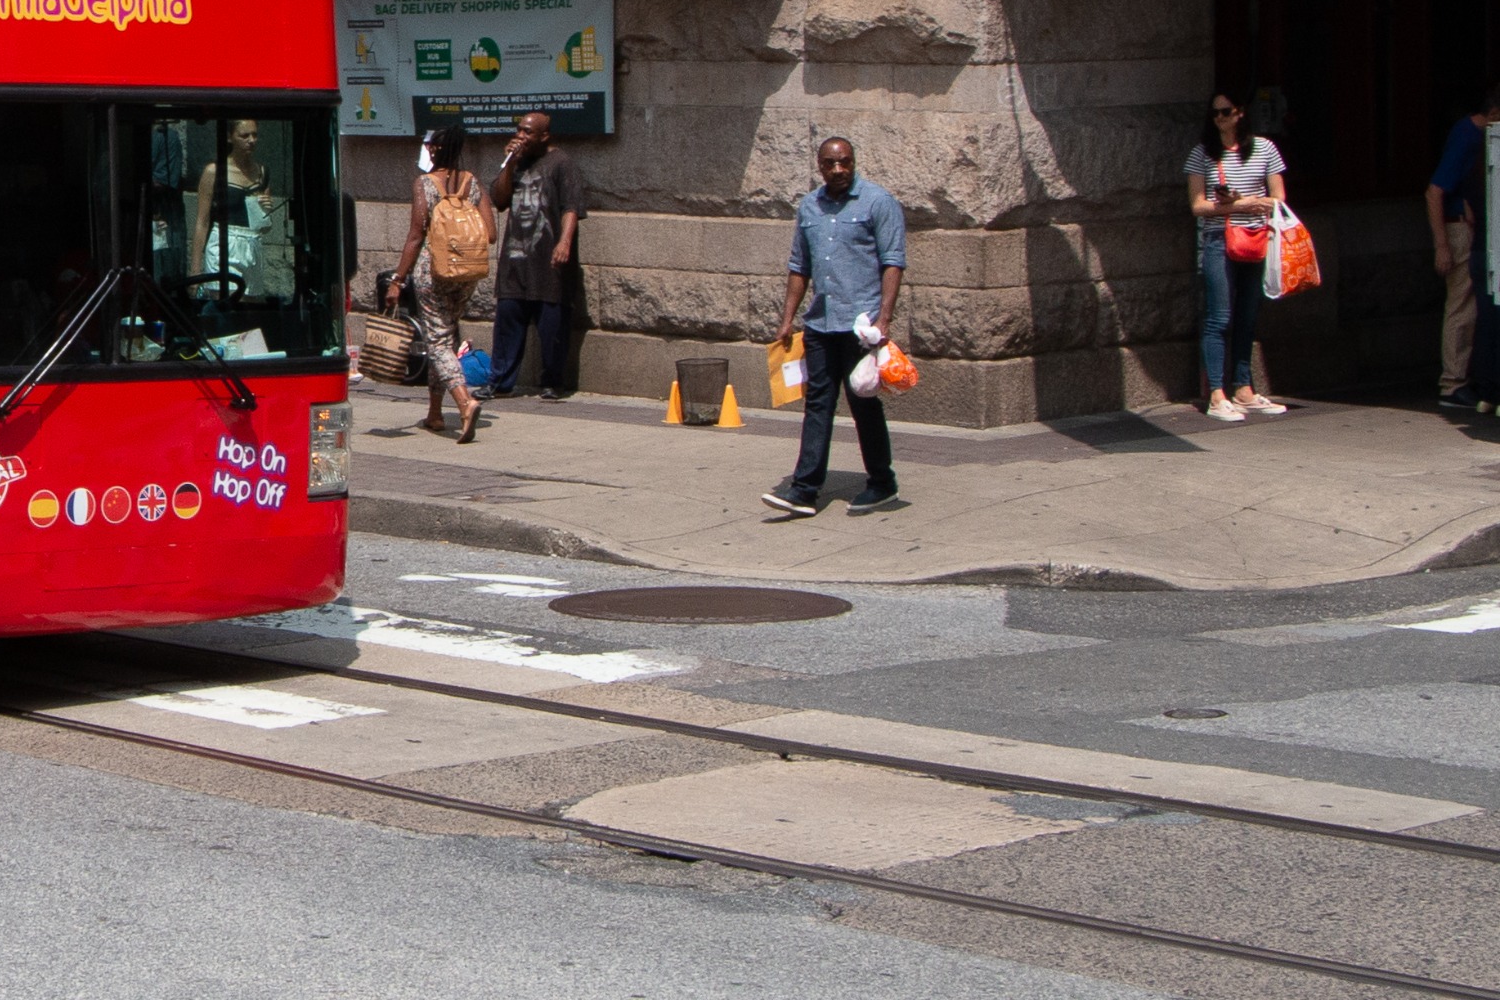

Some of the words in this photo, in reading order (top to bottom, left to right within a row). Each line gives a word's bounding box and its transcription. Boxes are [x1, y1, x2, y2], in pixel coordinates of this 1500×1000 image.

[374, 3, 397, 15] BAG
[400, 1, 456, 15] DELIVERY
[460, 0, 521, 13] SHOPPING
[417, 42, 449, 51] CUSTOMER
[449, 96, 468, 104] SPEND
[527, 94, 552, 102] DELIVER
[572, 93, 589, 101] BAGS
[218, 436, 256, 469] Hop
[261, 444, 286, 473] On
[213, 471, 251, 503] Hop
[256, 478, 287, 507] Off
